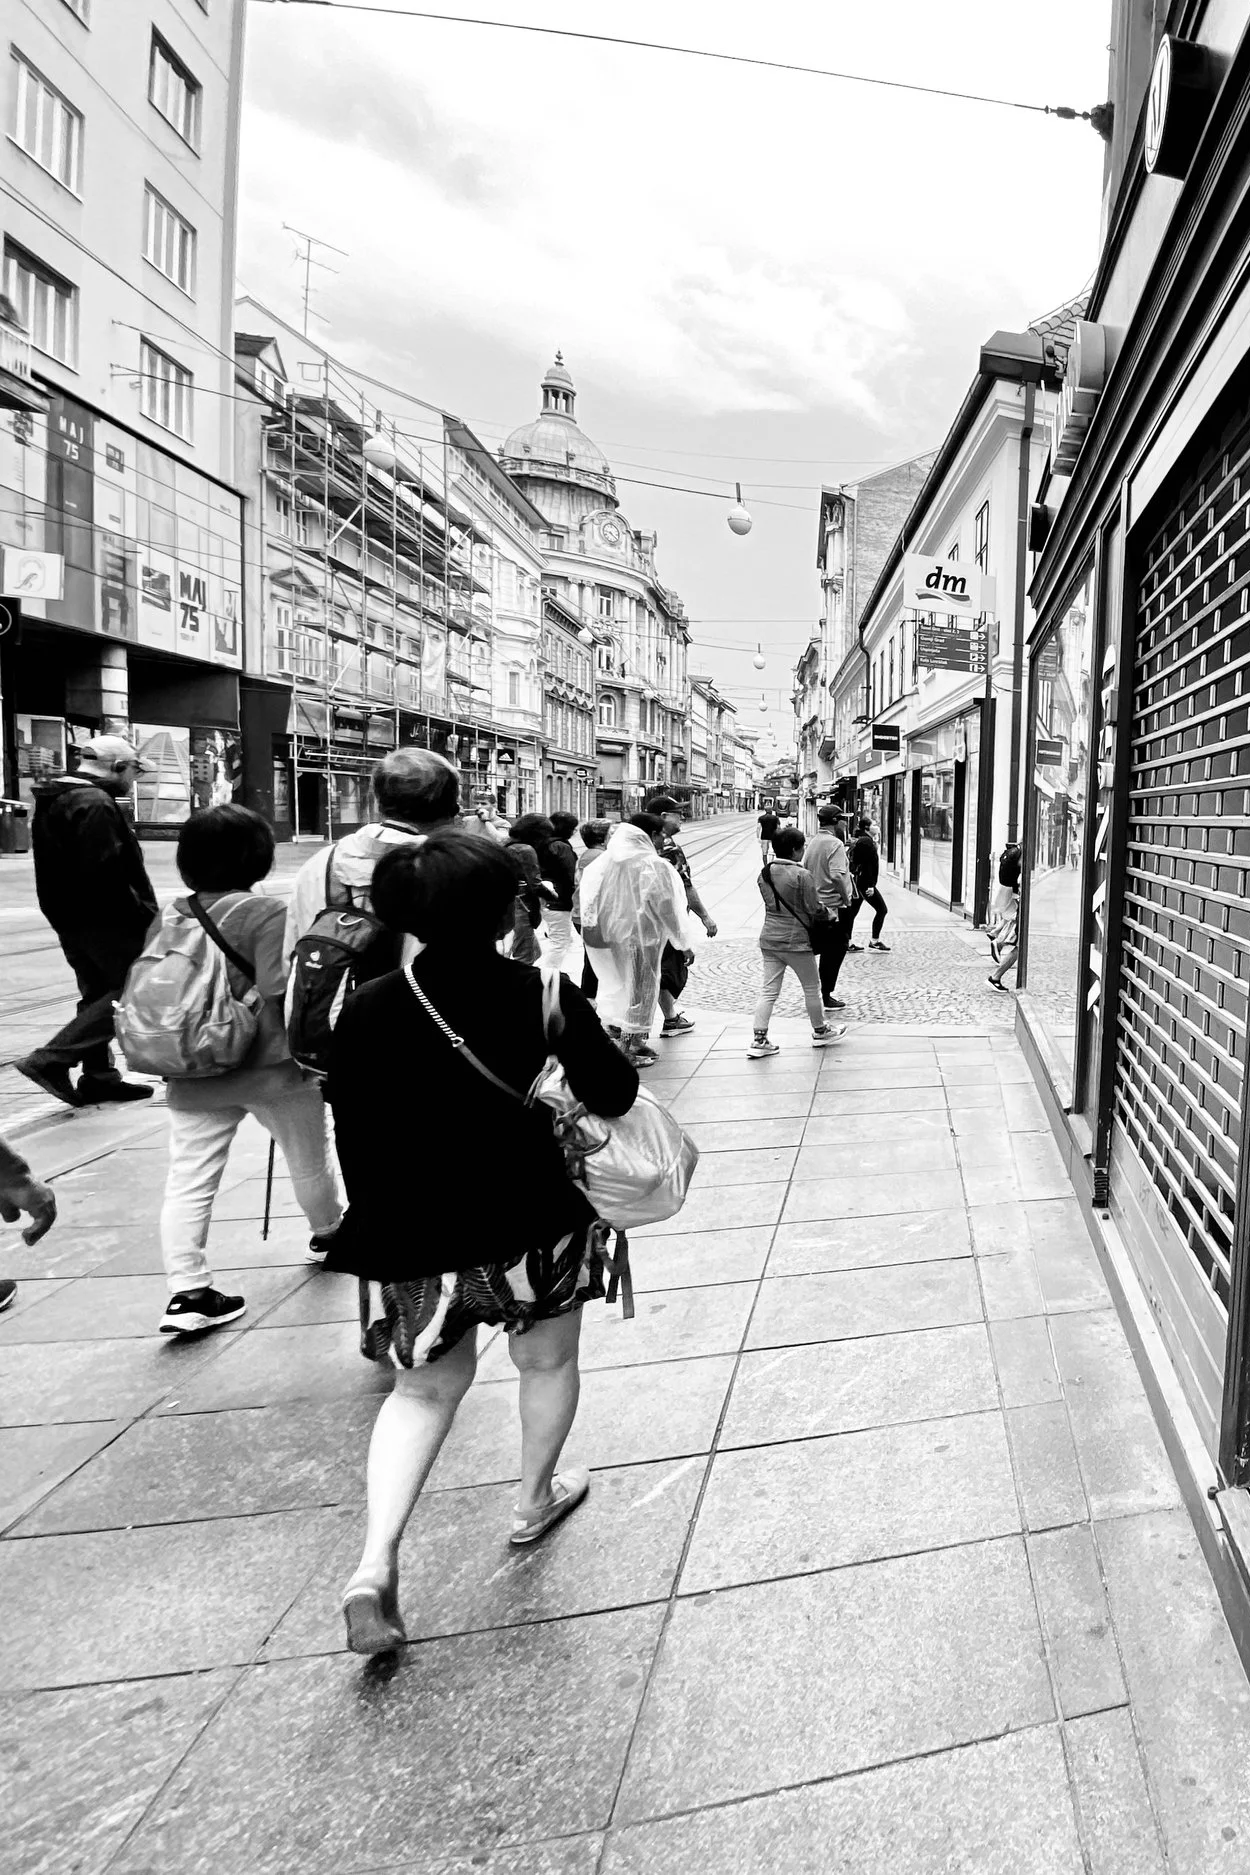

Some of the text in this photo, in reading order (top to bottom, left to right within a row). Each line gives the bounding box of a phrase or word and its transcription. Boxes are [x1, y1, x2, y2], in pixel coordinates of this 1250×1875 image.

[59, 415, 84, 445] MAJ
[63, 439, 79, 460] 75
[179, 571, 206, 612] MAJ
[925, 565, 967, 594] dm
[179, 602, 199, 633] 75
